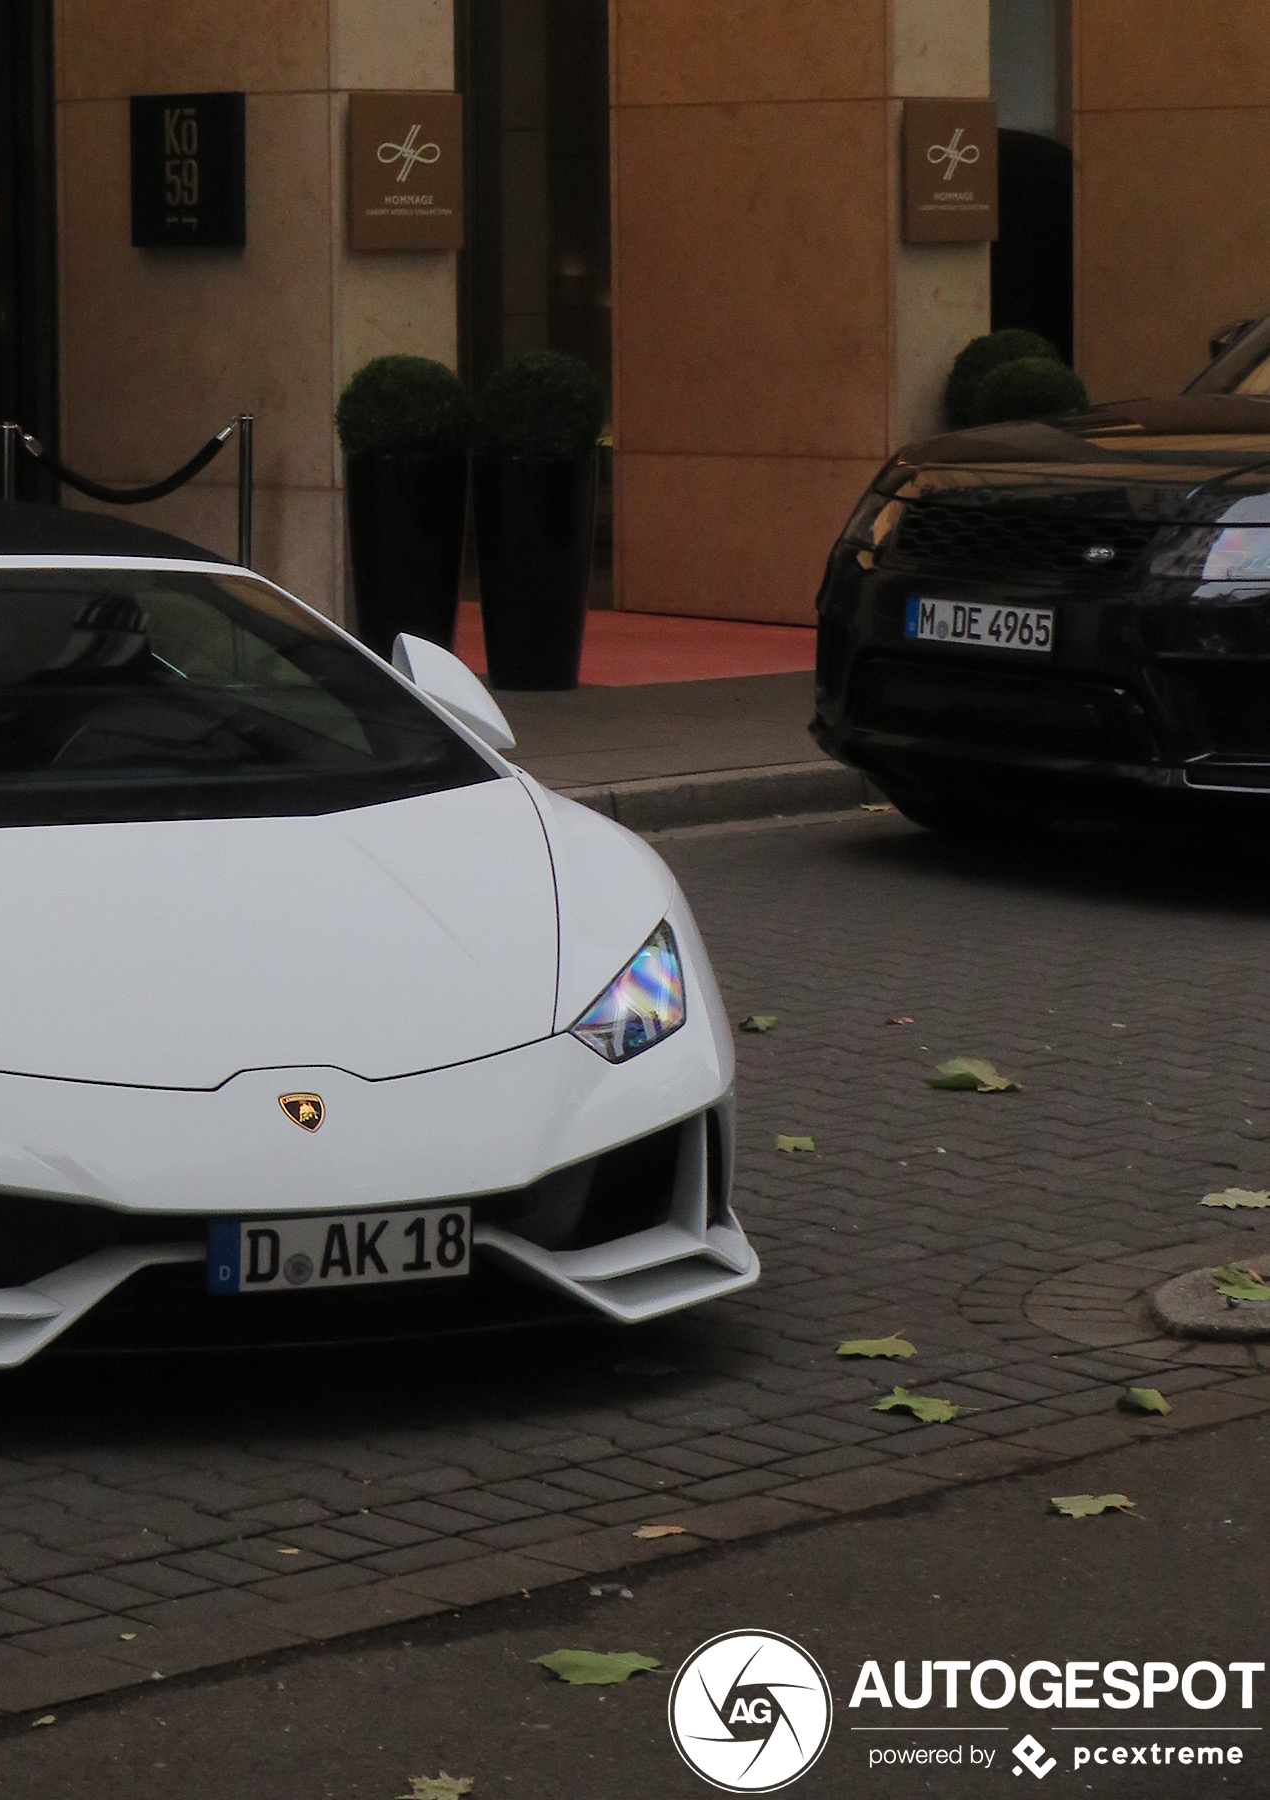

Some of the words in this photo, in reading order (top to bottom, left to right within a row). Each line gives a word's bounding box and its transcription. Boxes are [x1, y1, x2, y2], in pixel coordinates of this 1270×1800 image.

[164, 158, 199, 207] 59
[933, 192, 974, 201] HOMMAGE
[384, 194, 434, 205] HOMMAGE
[920, 603, 935, 634] M
[952, 605, 982, 640] DE
[988, 610, 1051, 646] 4965
[246, 1228, 280, 1283] D
[320, 1220, 389, 1278] AK
[402, 1213, 466, 1272] 18
[219, 1266, 231, 1281] D
